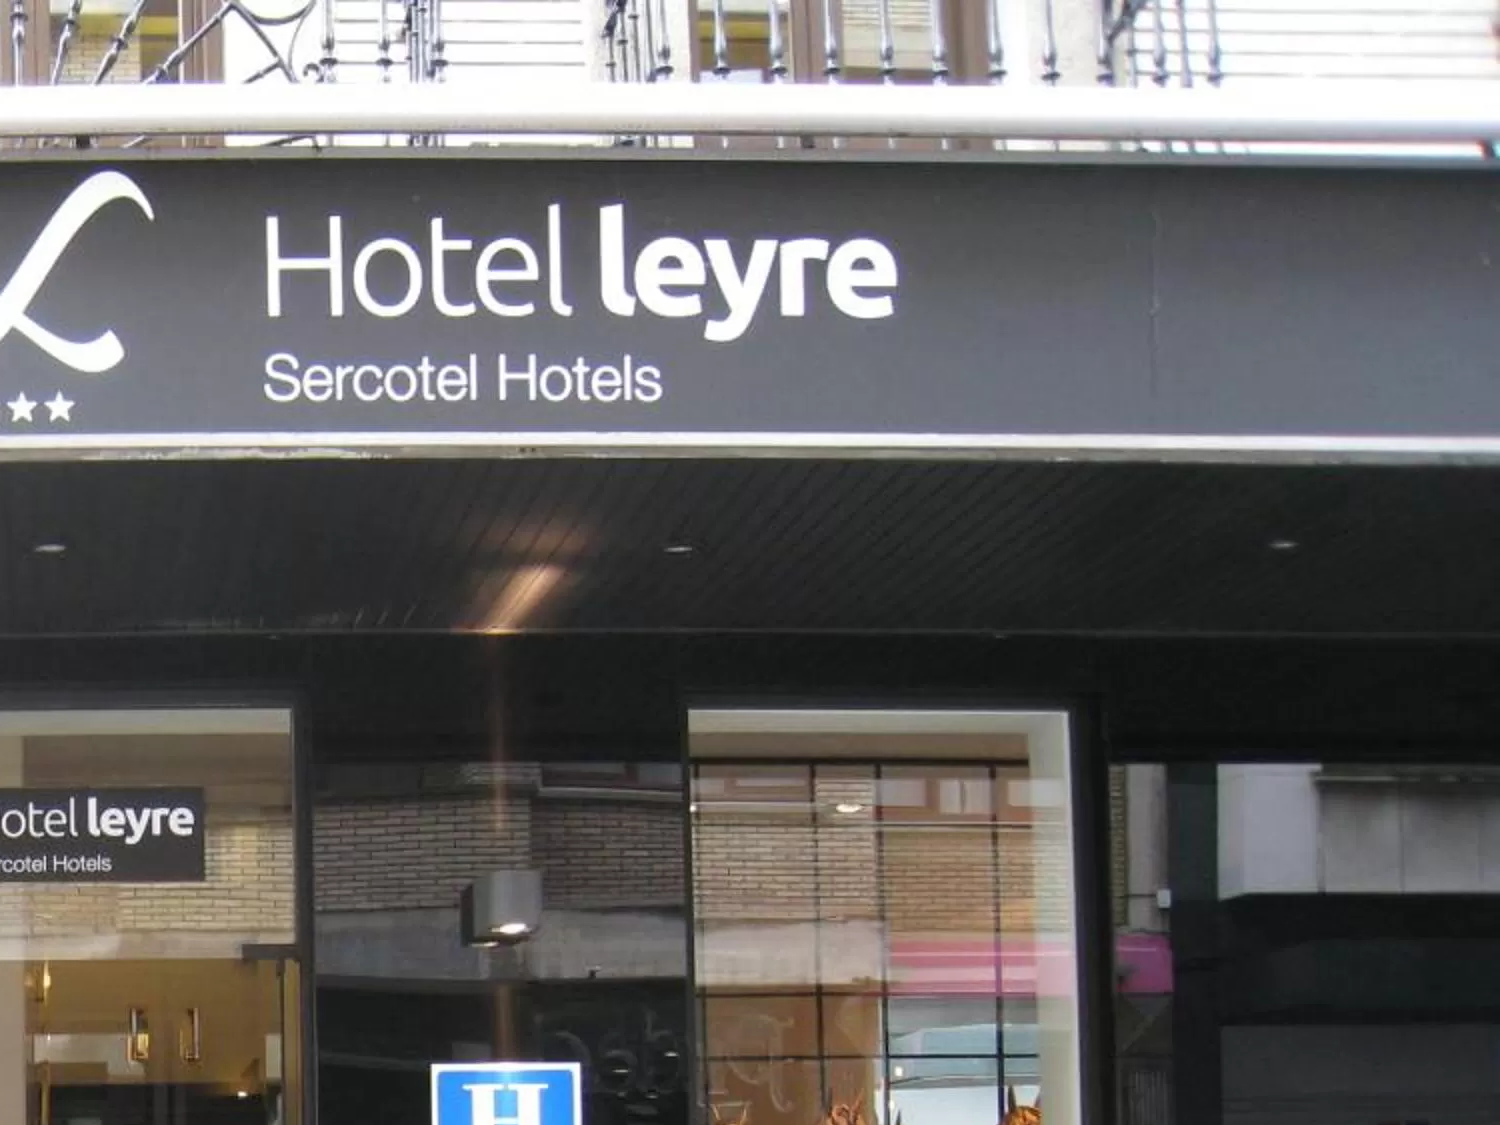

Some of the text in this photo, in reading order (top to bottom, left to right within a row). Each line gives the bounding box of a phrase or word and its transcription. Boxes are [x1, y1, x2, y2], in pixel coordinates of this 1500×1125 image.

[266, 203, 898, 343] Hotel leyre
[263, 352, 663, 403] Sercotel Hotels
[87, 796, 195, 845] leyre
[52, 853, 113, 873] Hotels
